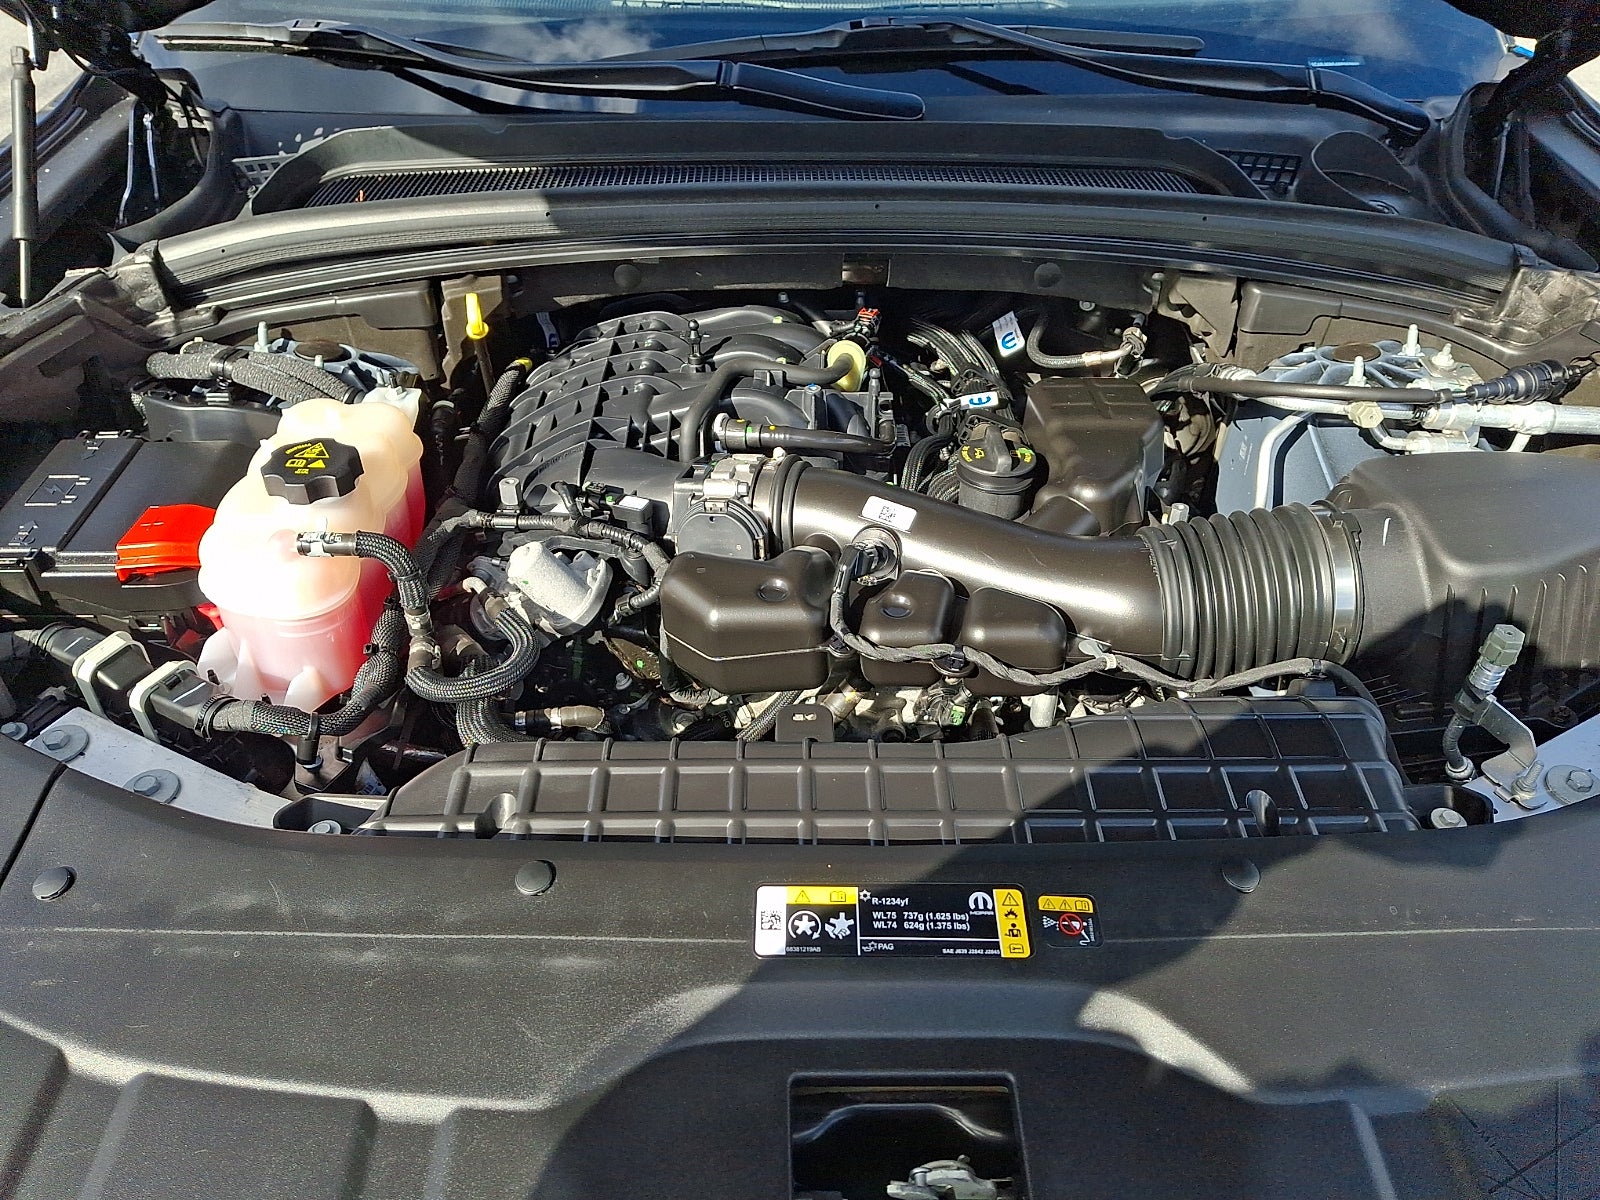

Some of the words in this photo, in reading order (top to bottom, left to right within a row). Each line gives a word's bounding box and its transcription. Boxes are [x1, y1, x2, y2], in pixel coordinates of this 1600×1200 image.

[871, 897, 909, 907] R-1234yf
[872, 911, 897, 920] WL75
[903, 912, 924, 921] 737g
[925, 912, 951, 921] (1.625
[952, 912, 969, 921] lbs)
[872, 921, 898, 929] WL74
[903, 922, 925, 931] 624g
[926, 922, 952, 931] (1.375
[953, 922, 971, 931] lbs)
[877, 942, 895, 950] PAG
